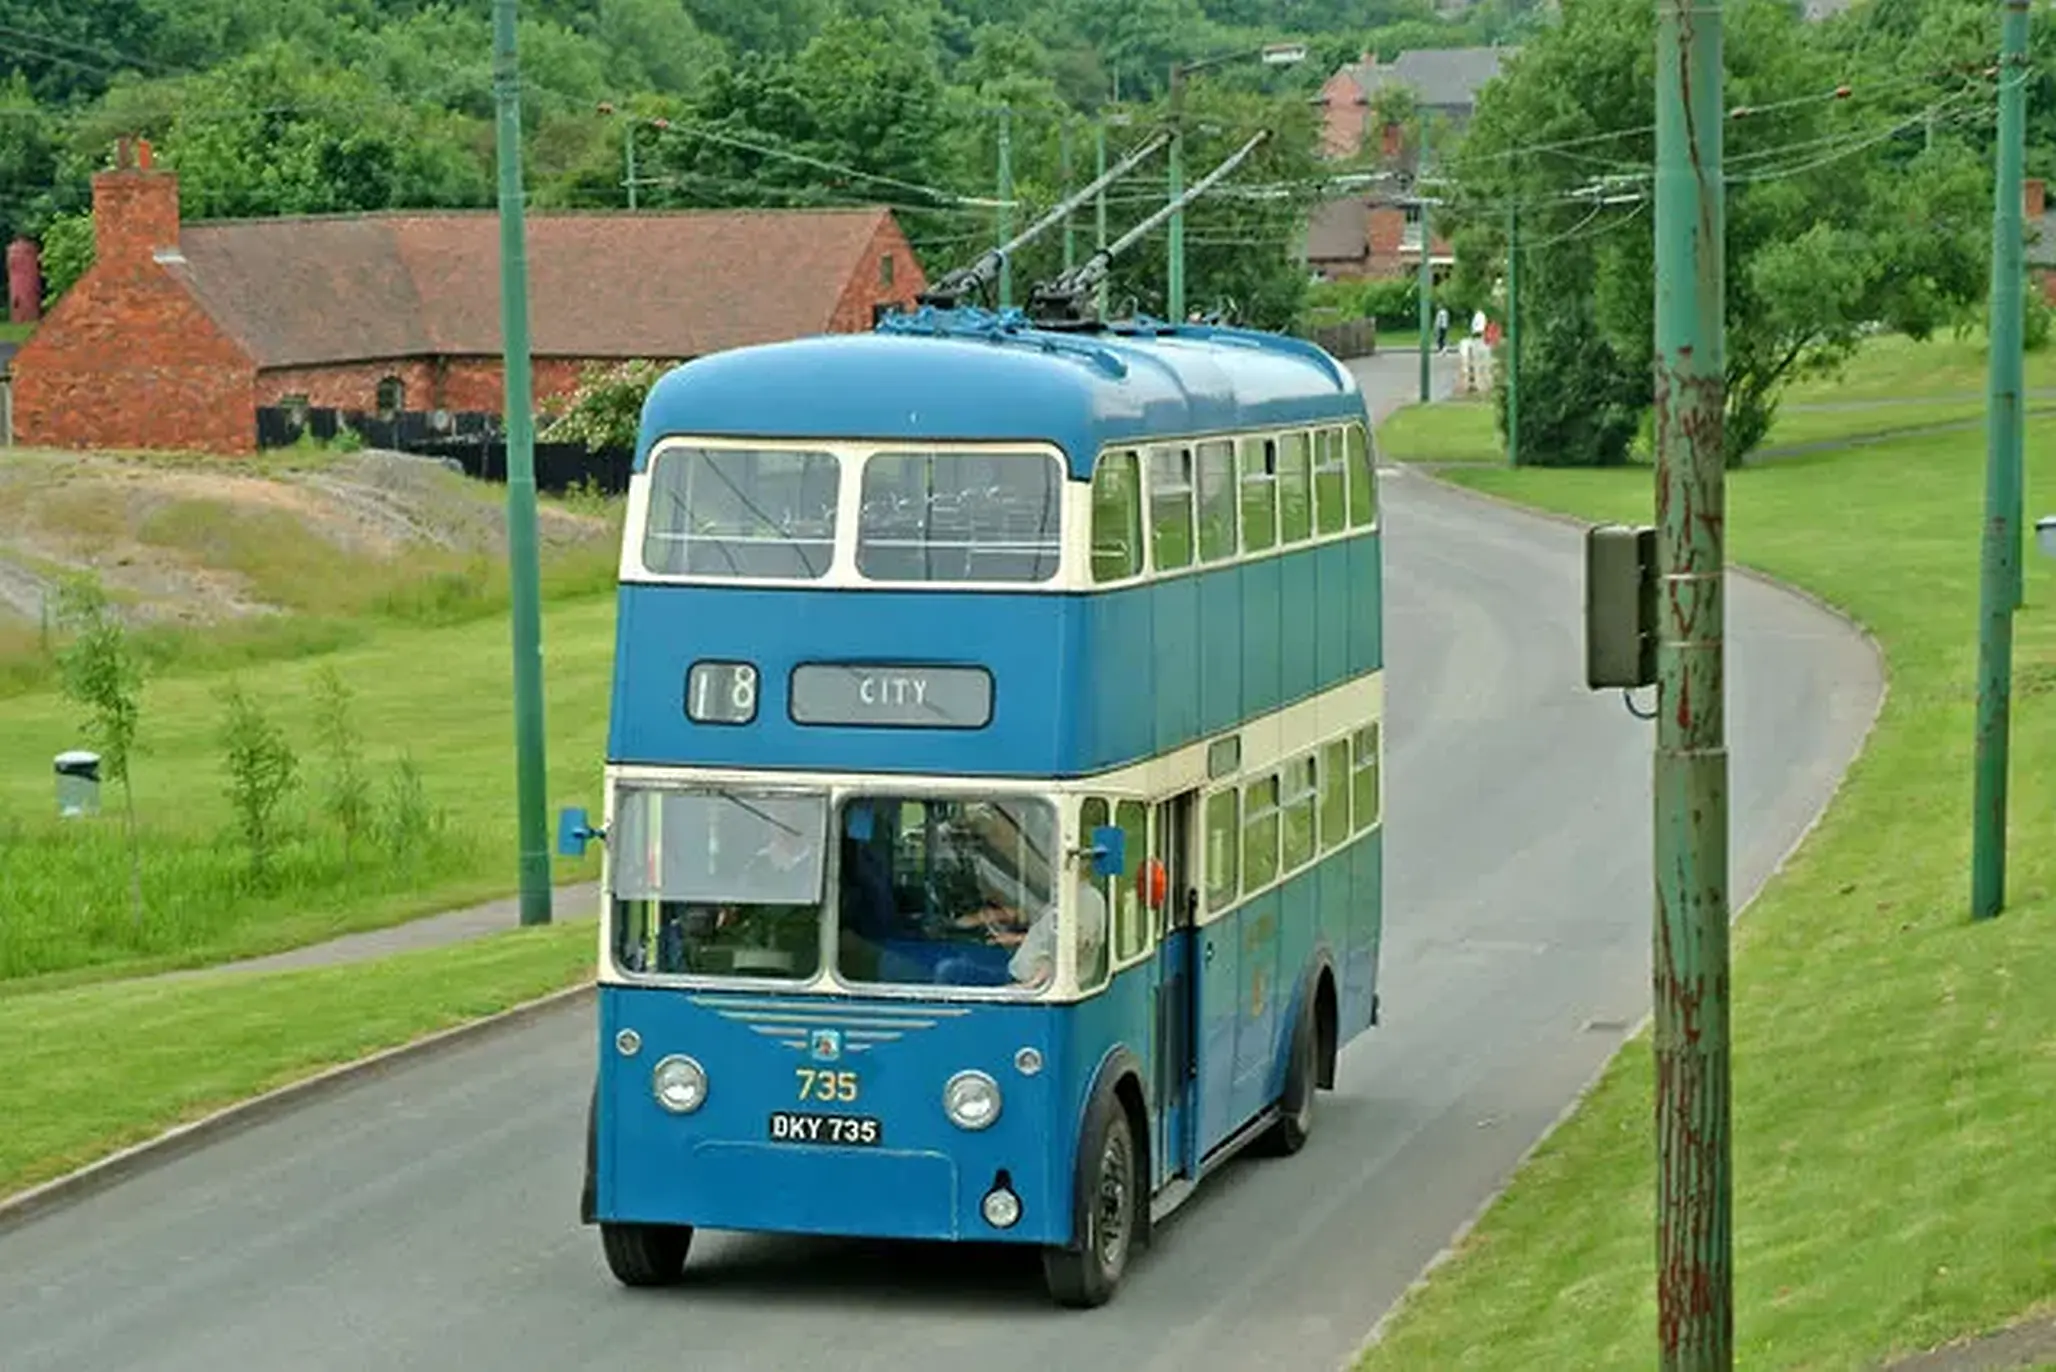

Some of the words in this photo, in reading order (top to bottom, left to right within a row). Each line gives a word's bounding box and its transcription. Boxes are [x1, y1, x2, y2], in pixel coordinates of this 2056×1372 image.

[697, 667, 755, 719] 18
[860, 679, 926, 705] CITY
[796, 1069, 857, 1101] 735
[773, 1115, 822, 1139] DKY
[828, 1118, 877, 1142] 735
